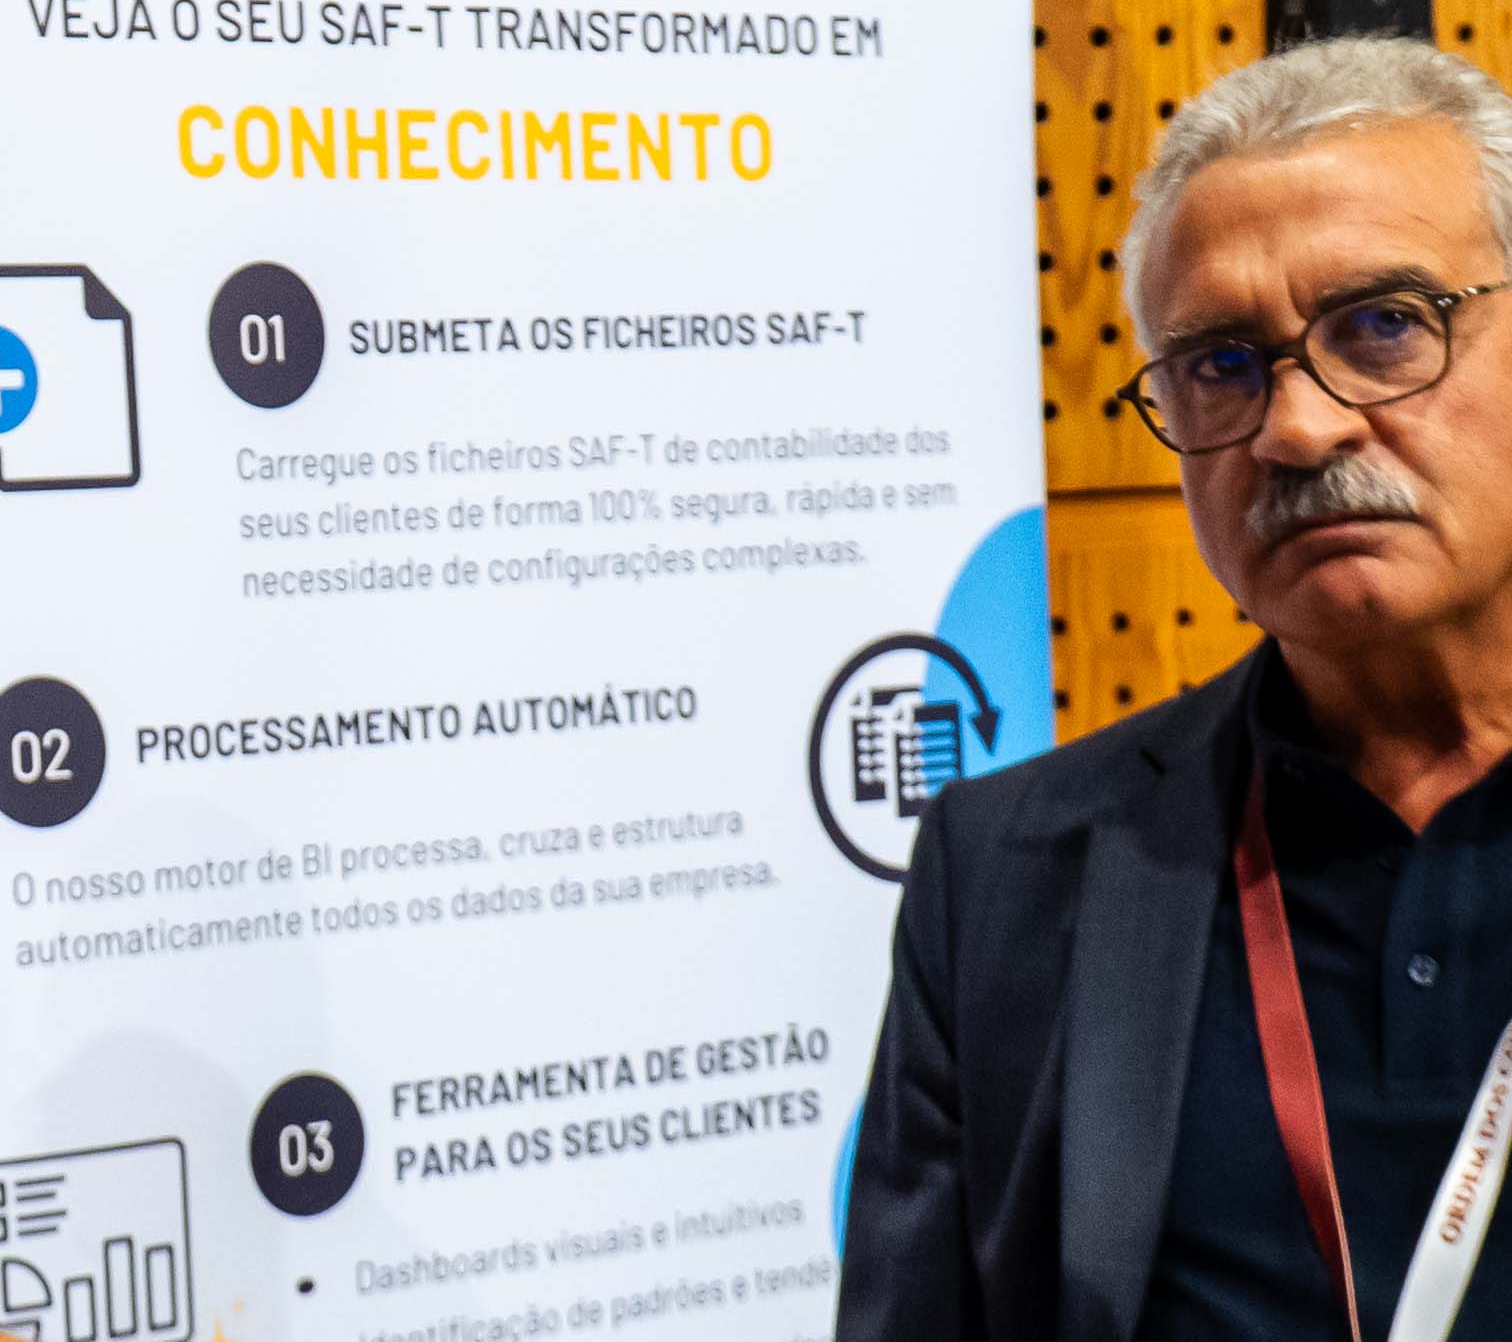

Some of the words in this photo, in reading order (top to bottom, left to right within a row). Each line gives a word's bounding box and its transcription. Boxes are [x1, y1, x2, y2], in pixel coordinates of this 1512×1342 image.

[321, 0, 451, 48] SAF-T
[465, 5, 819, 56] TRANSFORMADO
[832, 15, 884, 57] EM
[177, 103, 773, 182] CONHECIMENTO
[239, 313, 286, 365] 01
[350, 315, 521, 355] SUBMETA
[530, 315, 573, 351] OS
[583, 312, 756, 351] FICHEIROS
[766, 309, 866, 347] SAF-T
[237, 446, 375, 486] Carregue
[384, 450, 419, 477] os
[428, 438, 561, 474] ficheiros
[568, 433, 655, 468] SAF-T
[663, 432, 698, 465] de
[706, 425, 898, 463] contabilidade
[905, 424, 951, 456] dos
[240, 507, 309, 539] seus
[318, 502, 440, 537] clientes
[448, 495, 484, 532] de
[493, 492, 582, 529] forma
[588, 488, 660, 525] 100%
[785, 478, 874, 520] rápida
[881, 485, 896, 508] e
[902, 479, 958, 509] sem
[243, 559, 434, 598] necessidade
[442, 552, 478, 588] de
[487, 543, 696, 590] configurações
[701, 537, 866, 577] complexas.
[136, 704, 461, 763] PROCESSAMENTO
[472, 683, 698, 737] AUTOMÁTICO
[10, 728, 74, 785] 02
[12, 870, 36, 907] O
[45, 868, 146, 906] nosso
[154, 853, 248, 894] motor
[256, 848, 294, 881] de
[302, 842, 333, 877] BI
[340, 833, 490, 878] processa,
[499, 829, 582, 860] cruza
[588, 822, 604, 849] e
[612, 806, 744, 849] estrutura
[14, 907, 302, 968] automaticamente
[311, 896, 400, 935] todos
[407, 895, 444, 924] os
[451, 879, 543, 920] dados
[550, 871, 586, 910] da
[593, 874, 643, 906] sua
[649, 859, 780, 900] empresa.
[391, 1053, 637, 1120] FERRAMENTA
[644, 1045, 687, 1084] DE
[695, 1022, 830, 1078] GESTÃO
[278, 1118, 335, 1177] 03
[394, 1135, 497, 1183] PARA
[506, 1128, 553, 1164] OS
[562, 1115, 651, 1158] SEUS
[660, 1088, 822, 1143] CLIENTES
[354, 1236, 538, 1296] Dashboards
[545, 1220, 644, 1263] visuais
[650, 1220, 670, 1245] e
[676, 1196, 805, 1244] intuitivos
[566, 1298, 603, 1331] de
[731, 1271, 751, 1300] e
